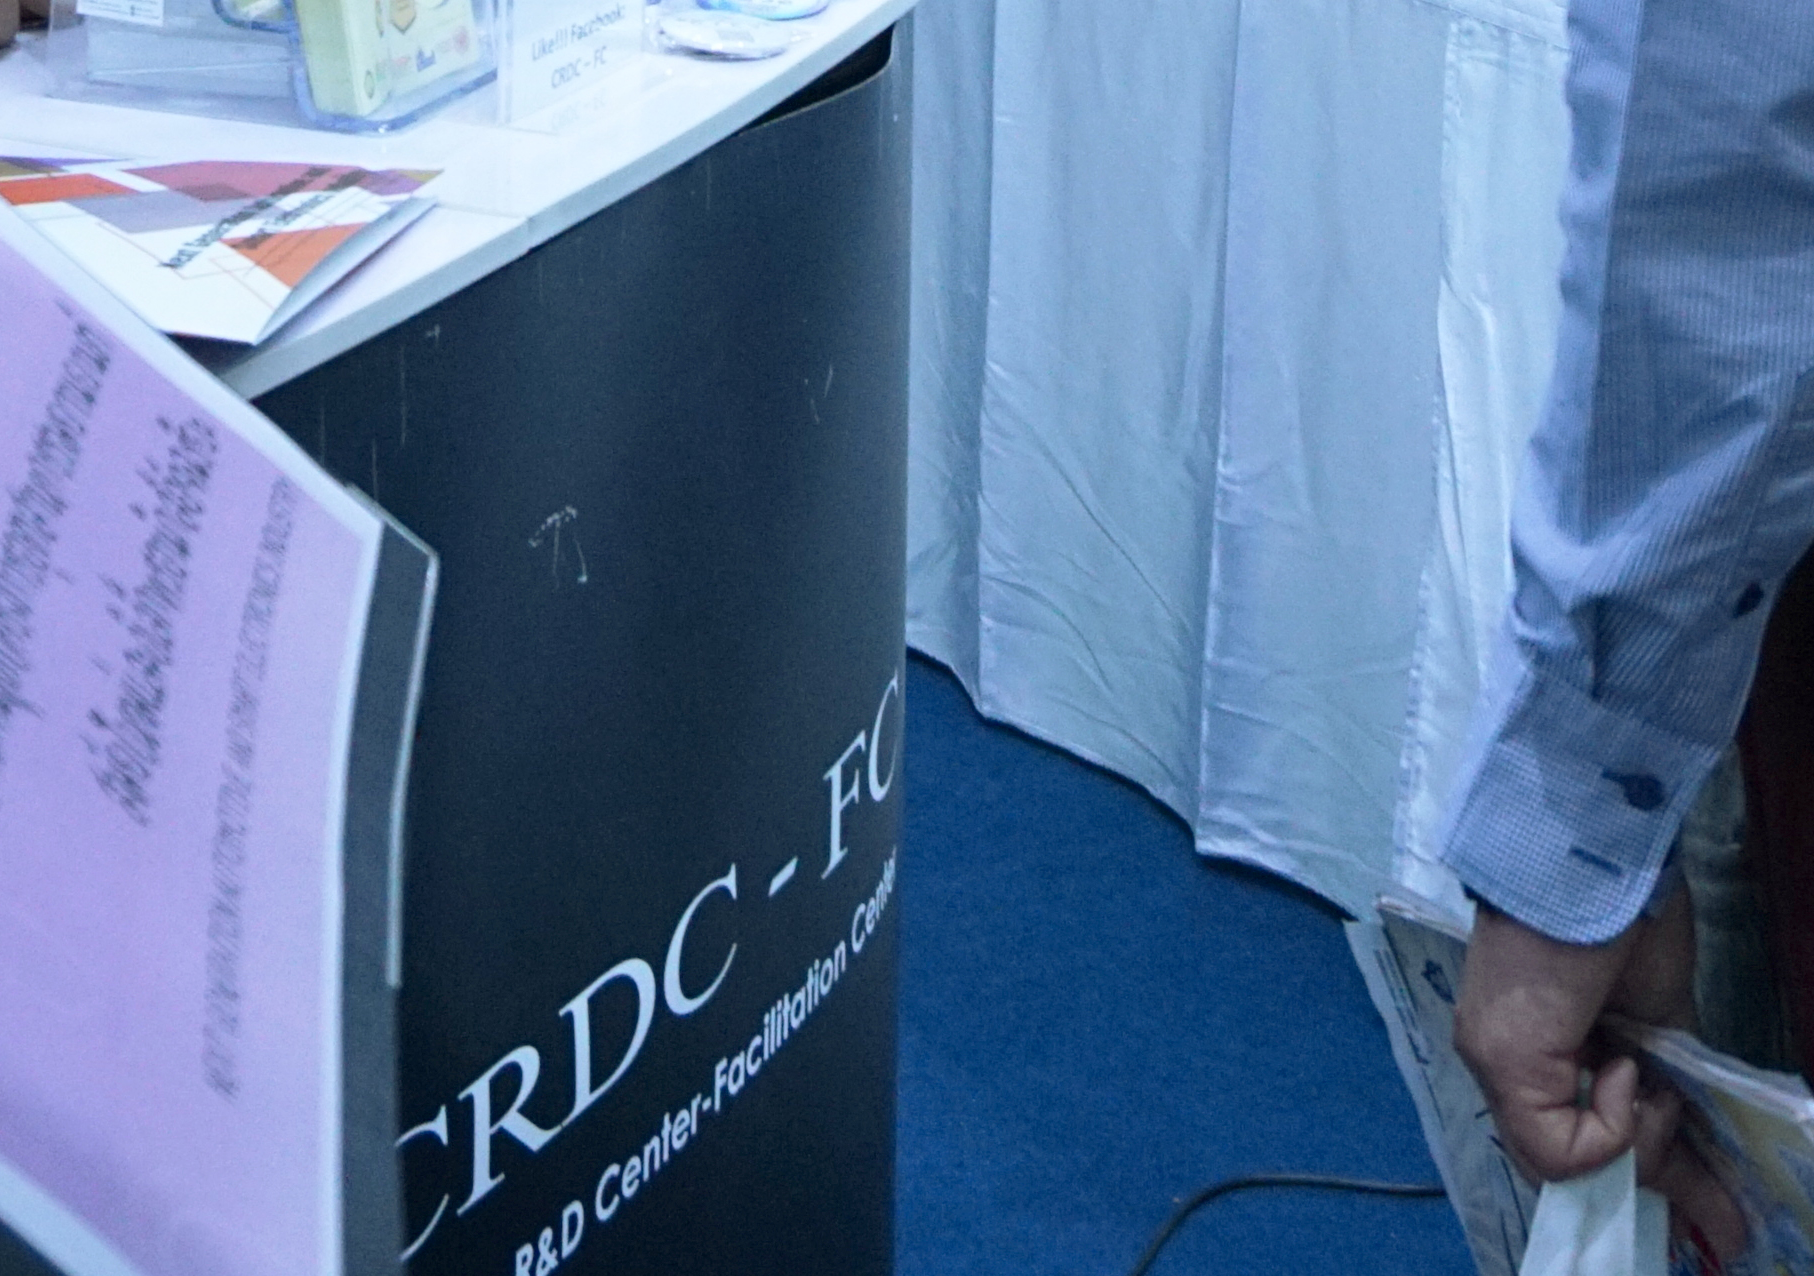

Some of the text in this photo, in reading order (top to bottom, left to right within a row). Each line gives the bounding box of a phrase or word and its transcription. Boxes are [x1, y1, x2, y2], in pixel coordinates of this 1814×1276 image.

[551, 45, 607, 89] CRDC FC
[395, 862, 738, 1264] CRDC
[821, 668, 899, 881] FC
[515, 844, 897, 1276] R&D Center-Facilitation Center
